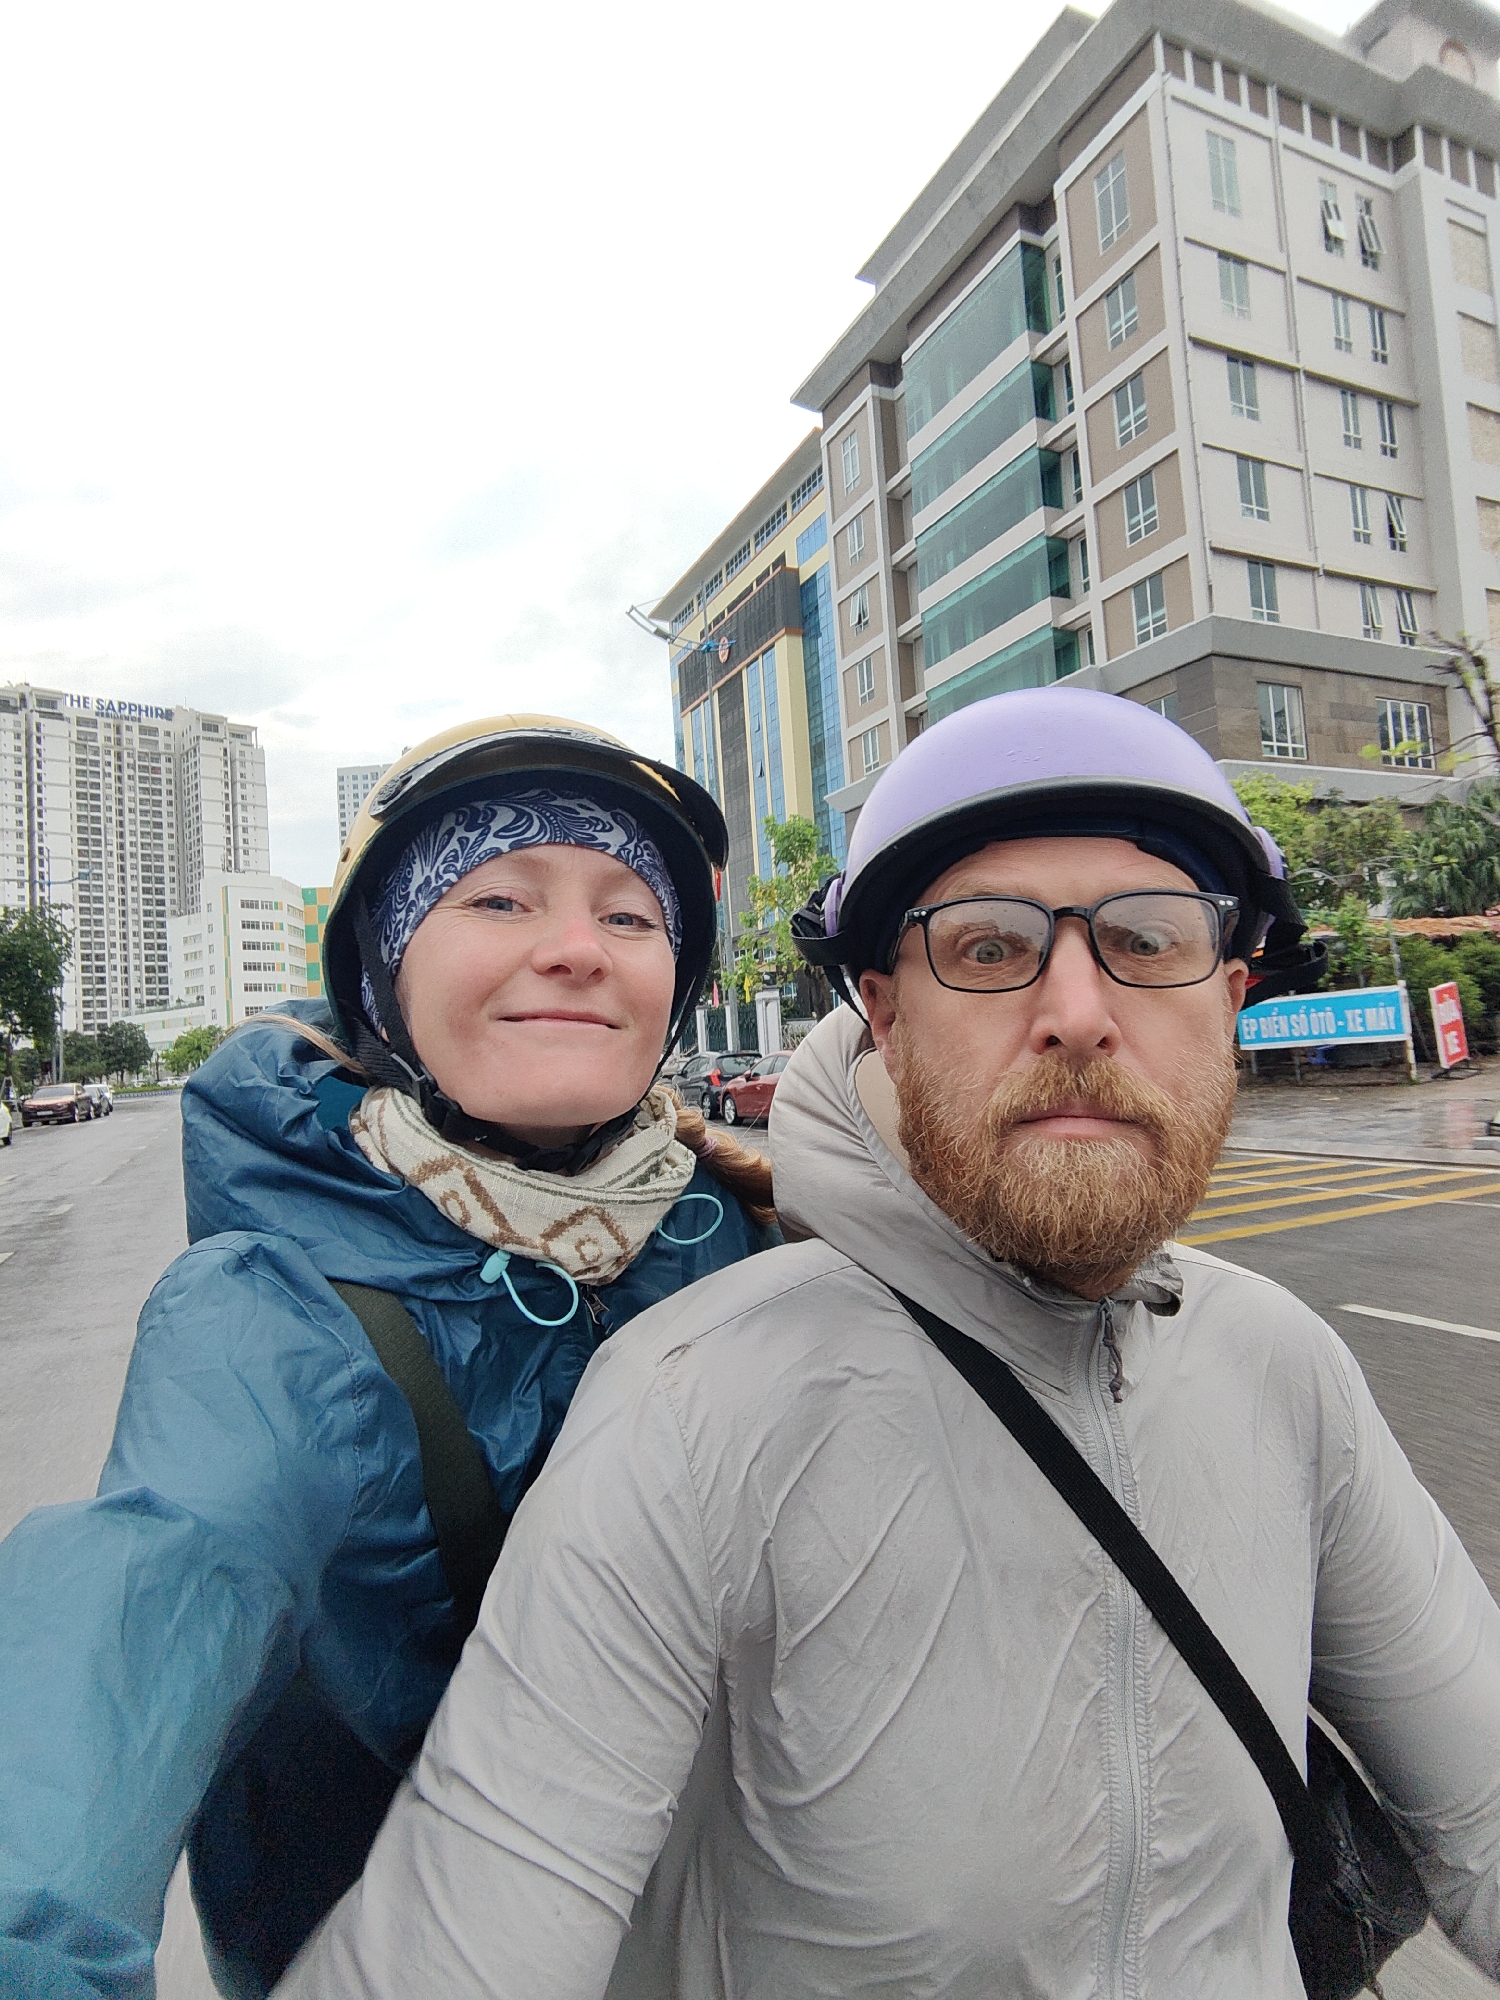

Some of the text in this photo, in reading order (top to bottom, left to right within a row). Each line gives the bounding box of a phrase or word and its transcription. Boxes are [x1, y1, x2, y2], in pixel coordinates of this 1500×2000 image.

[64, 693, 174, 721] THE SAPPHIRE
[1290, 1005, 1309, 1037] SỐ
[1345, 1009, 1365, 1033] XE
